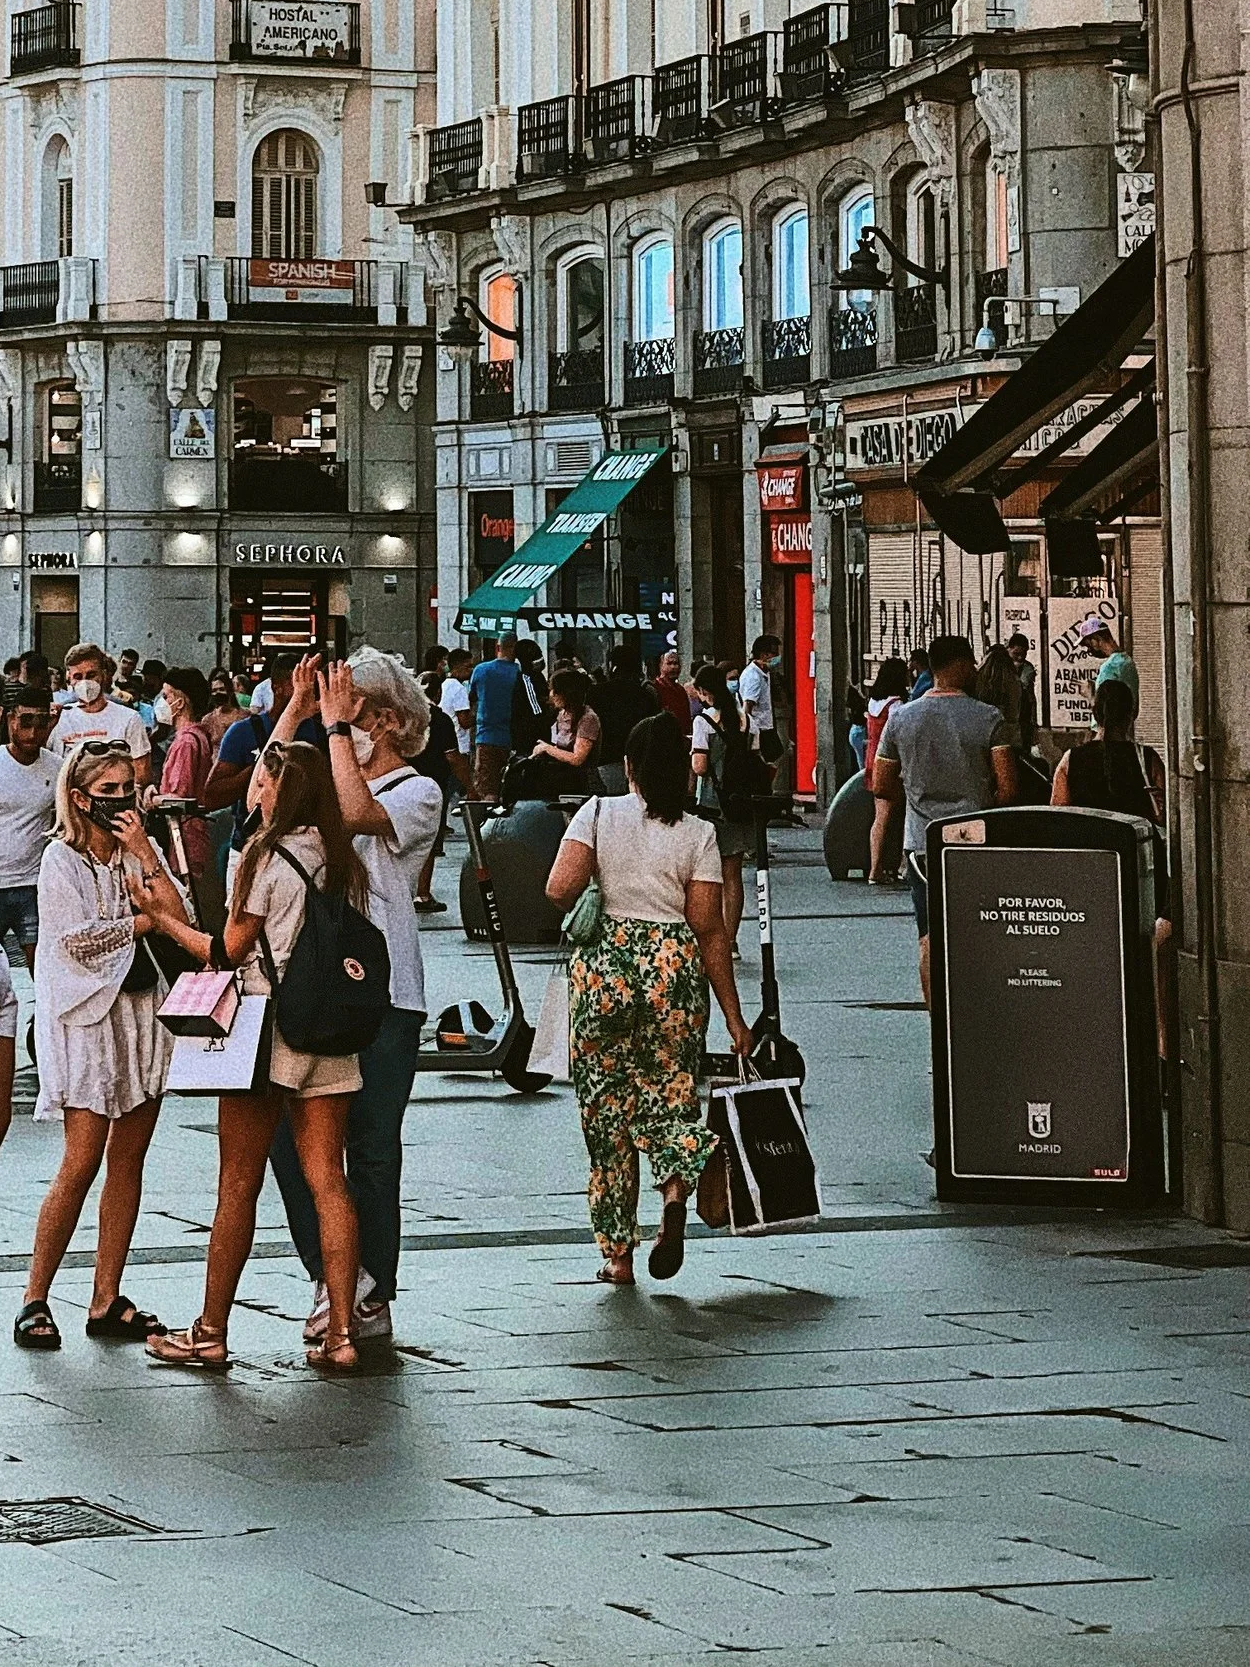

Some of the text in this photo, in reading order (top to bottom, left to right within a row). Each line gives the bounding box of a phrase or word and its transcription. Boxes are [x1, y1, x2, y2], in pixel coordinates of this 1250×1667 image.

[269, 8, 318, 23] HOSTAL
[263, 25, 339, 41] AMERICANO
[267, 262, 337, 279] SPANISH
[860, 412, 958, 465] CASA DE DIEGO
[592, 453, 658, 481] CHANGE
[28, 553, 78, 569] SEPHORA
[235, 543, 345, 565] SEPHORA
[537, 612, 653, 630] CHANGE
[486, 890, 501, 931] BIRD
[757, 883, 768, 931] BIRD
[998, 897, 1067, 910] POR FAVOR,
[979, 910, 1086, 922] NO TIRE RESIDUOS
[1005, 924, 1060, 935] AL SUELO
[1007, 978, 1062, 987] NO LITTERING
[1018, 1143, 1062, 1154] MADRID
[1093, 1168, 1121, 1177] SULO
